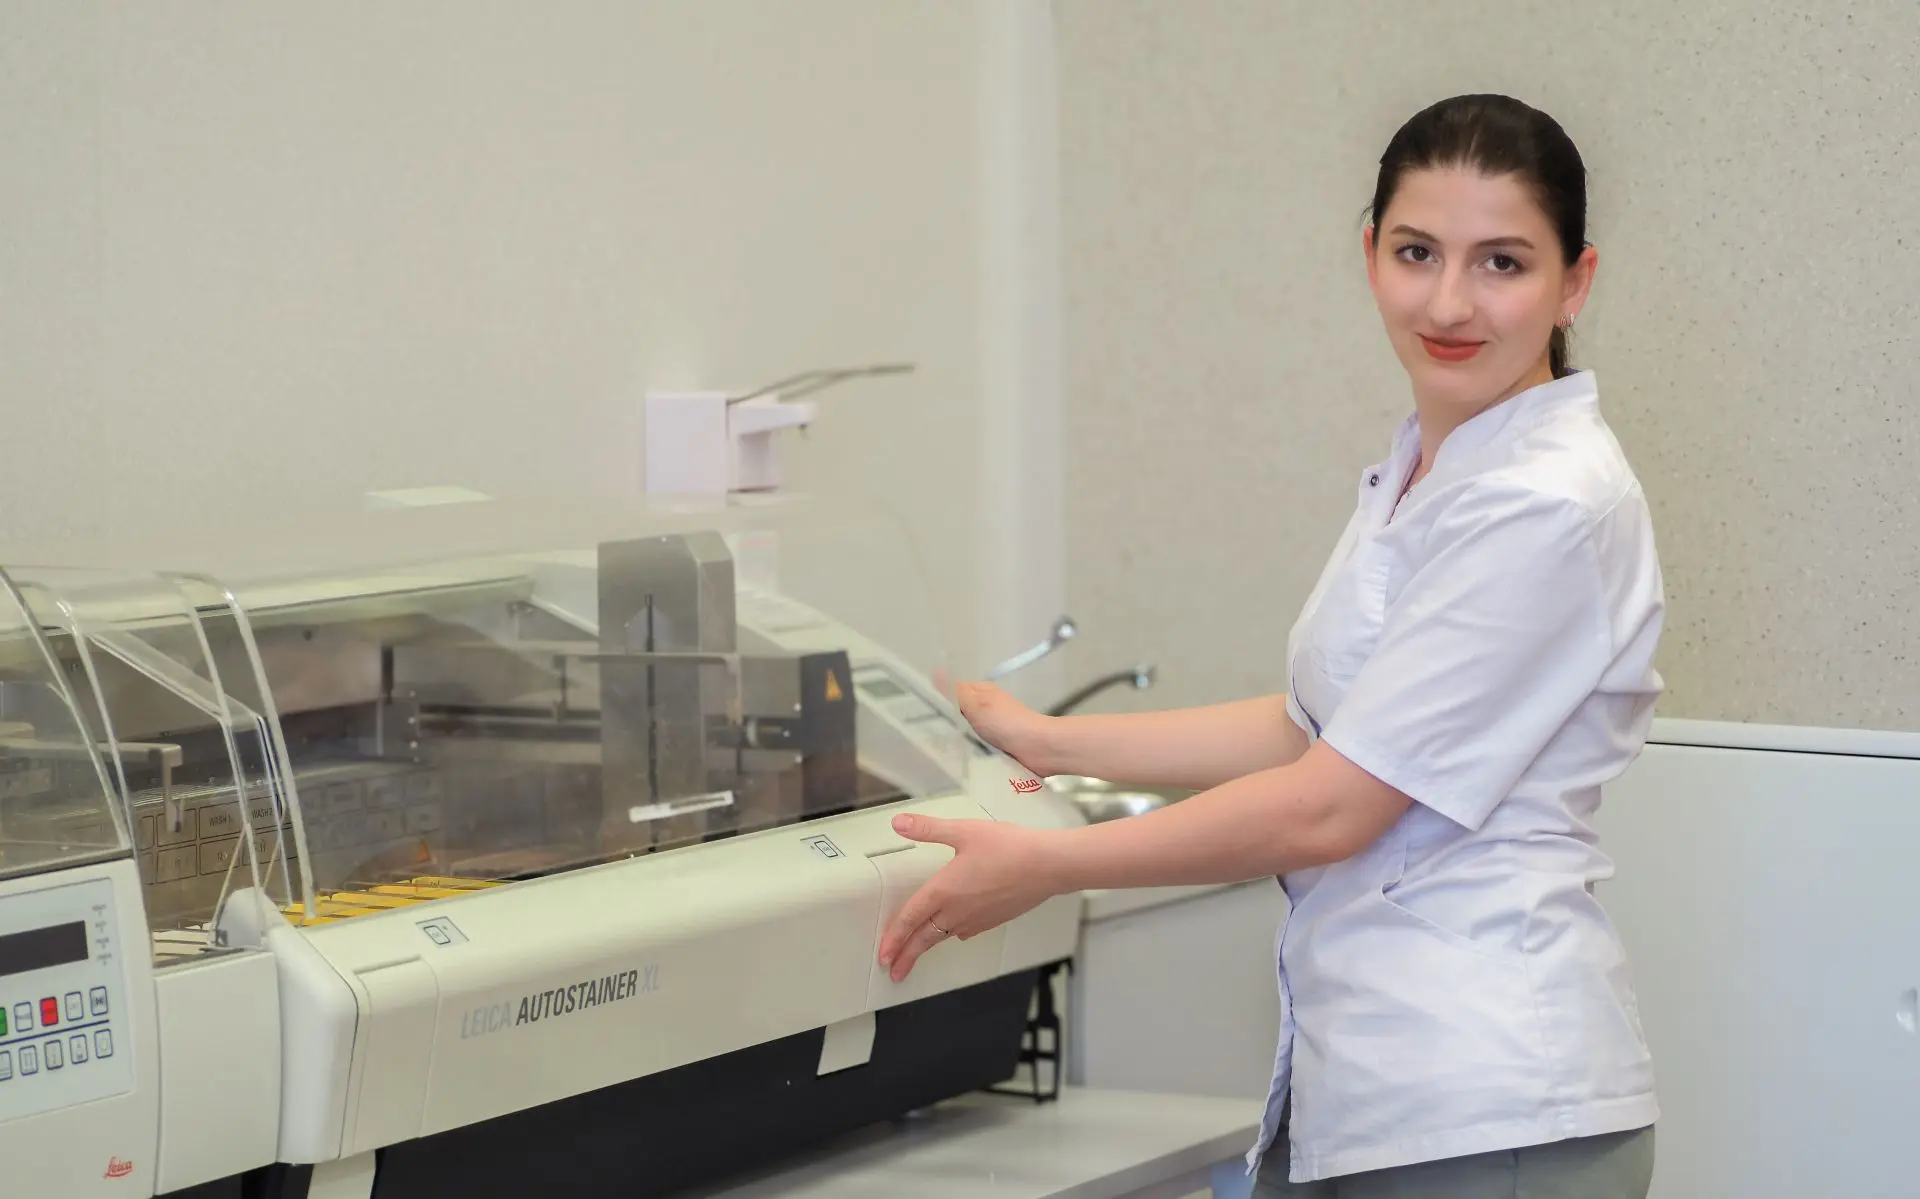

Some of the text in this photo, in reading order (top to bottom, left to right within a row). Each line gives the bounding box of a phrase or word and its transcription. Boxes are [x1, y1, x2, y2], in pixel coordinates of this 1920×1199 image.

[1009, 777, 1043, 794] Leica
[209, 814, 227, 827] WASH
[252, 807, 269, 819] WASH
[461, 963, 660, 1040] LEICA AUTOSTAINER XL
[104, 1155, 133, 1180] Leica
